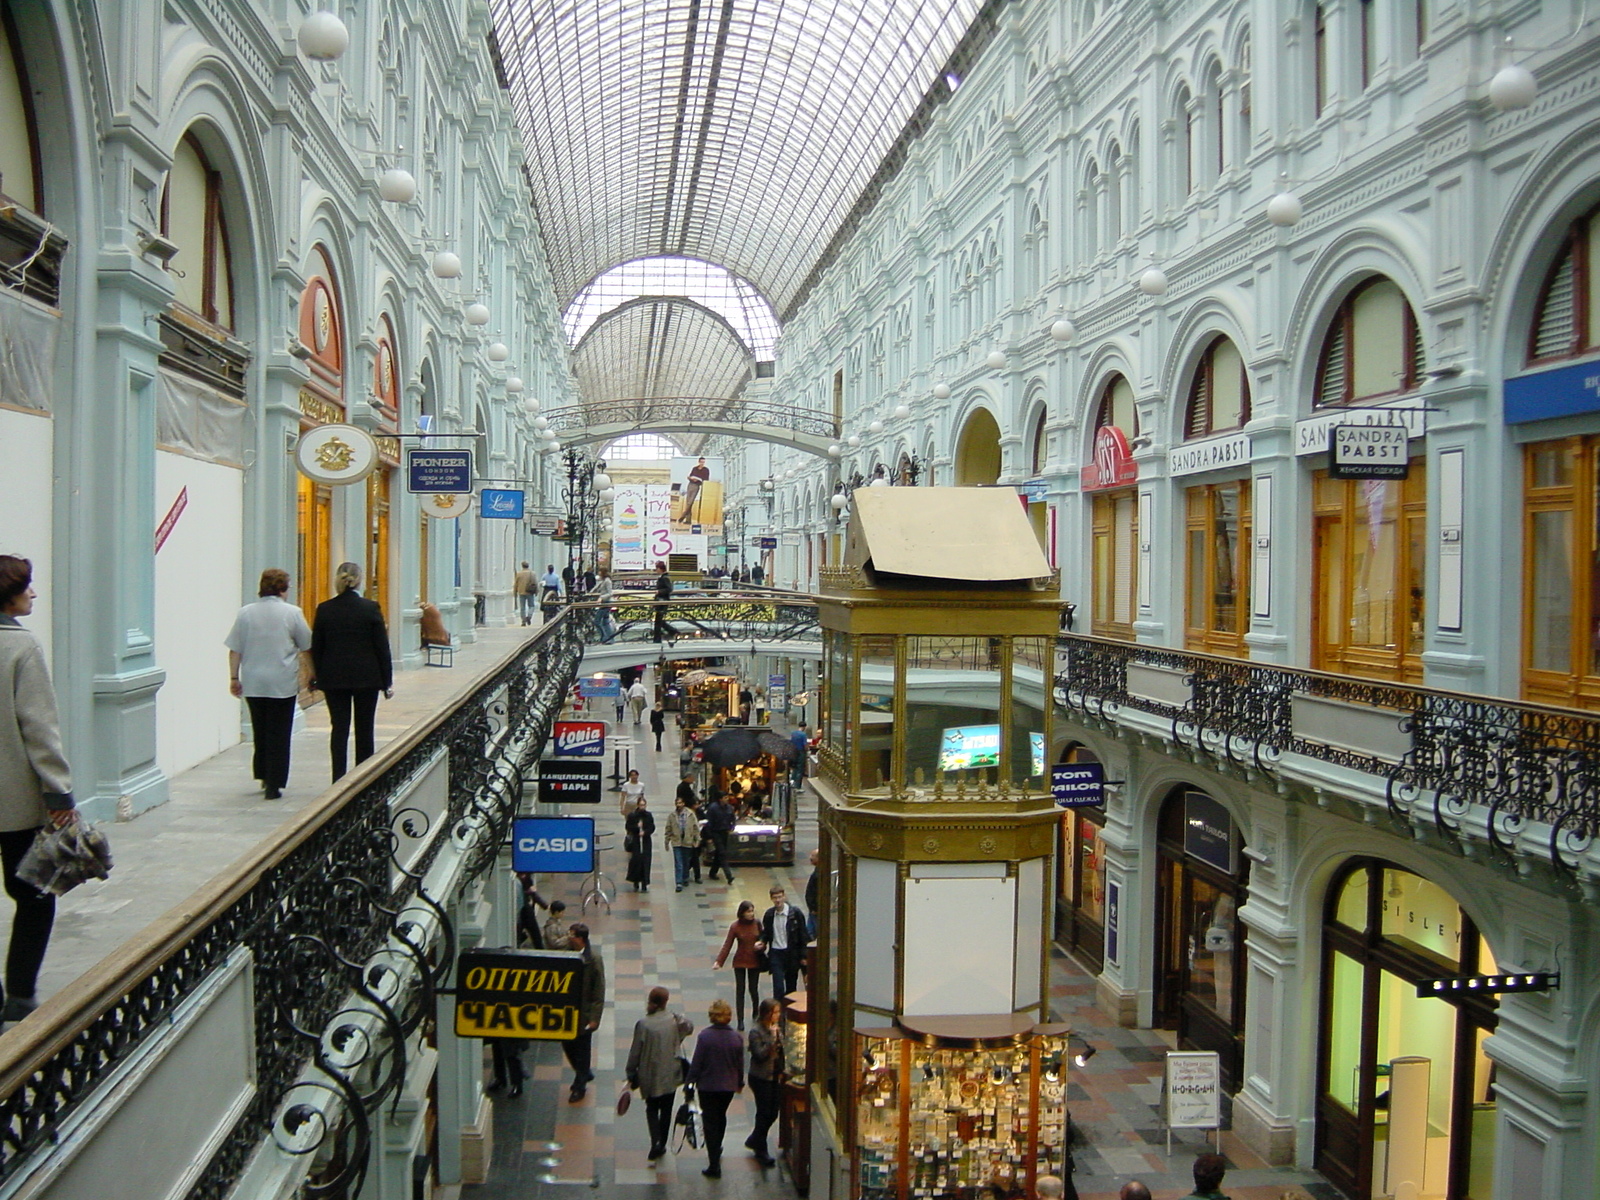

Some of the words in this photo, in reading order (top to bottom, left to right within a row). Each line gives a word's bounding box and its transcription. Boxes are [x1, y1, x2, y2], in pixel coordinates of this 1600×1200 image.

[1338, 430, 1404, 443] SANDRA
[1172, 449, 1208, 472] SANDRA
[1212, 440, 1243, 464] PABST
[1342, 445, 1400, 457] PABST
[412, 458, 467, 467] PIONEER
[1339, 467, 1372, 475] ЖЕНСКАЯ
[652, 530, 673, 556] 3
[550, 783, 590, 791] ТОВАРЫ
[519, 838, 588, 852] CASIO
[1383, 900, 1461, 943] SISLEY
[466, 967, 575, 993] ОПТИМ
[1433, 976, 1534, 990] SISLEY
[463, 1001, 575, 1032] ЧАСЫ
